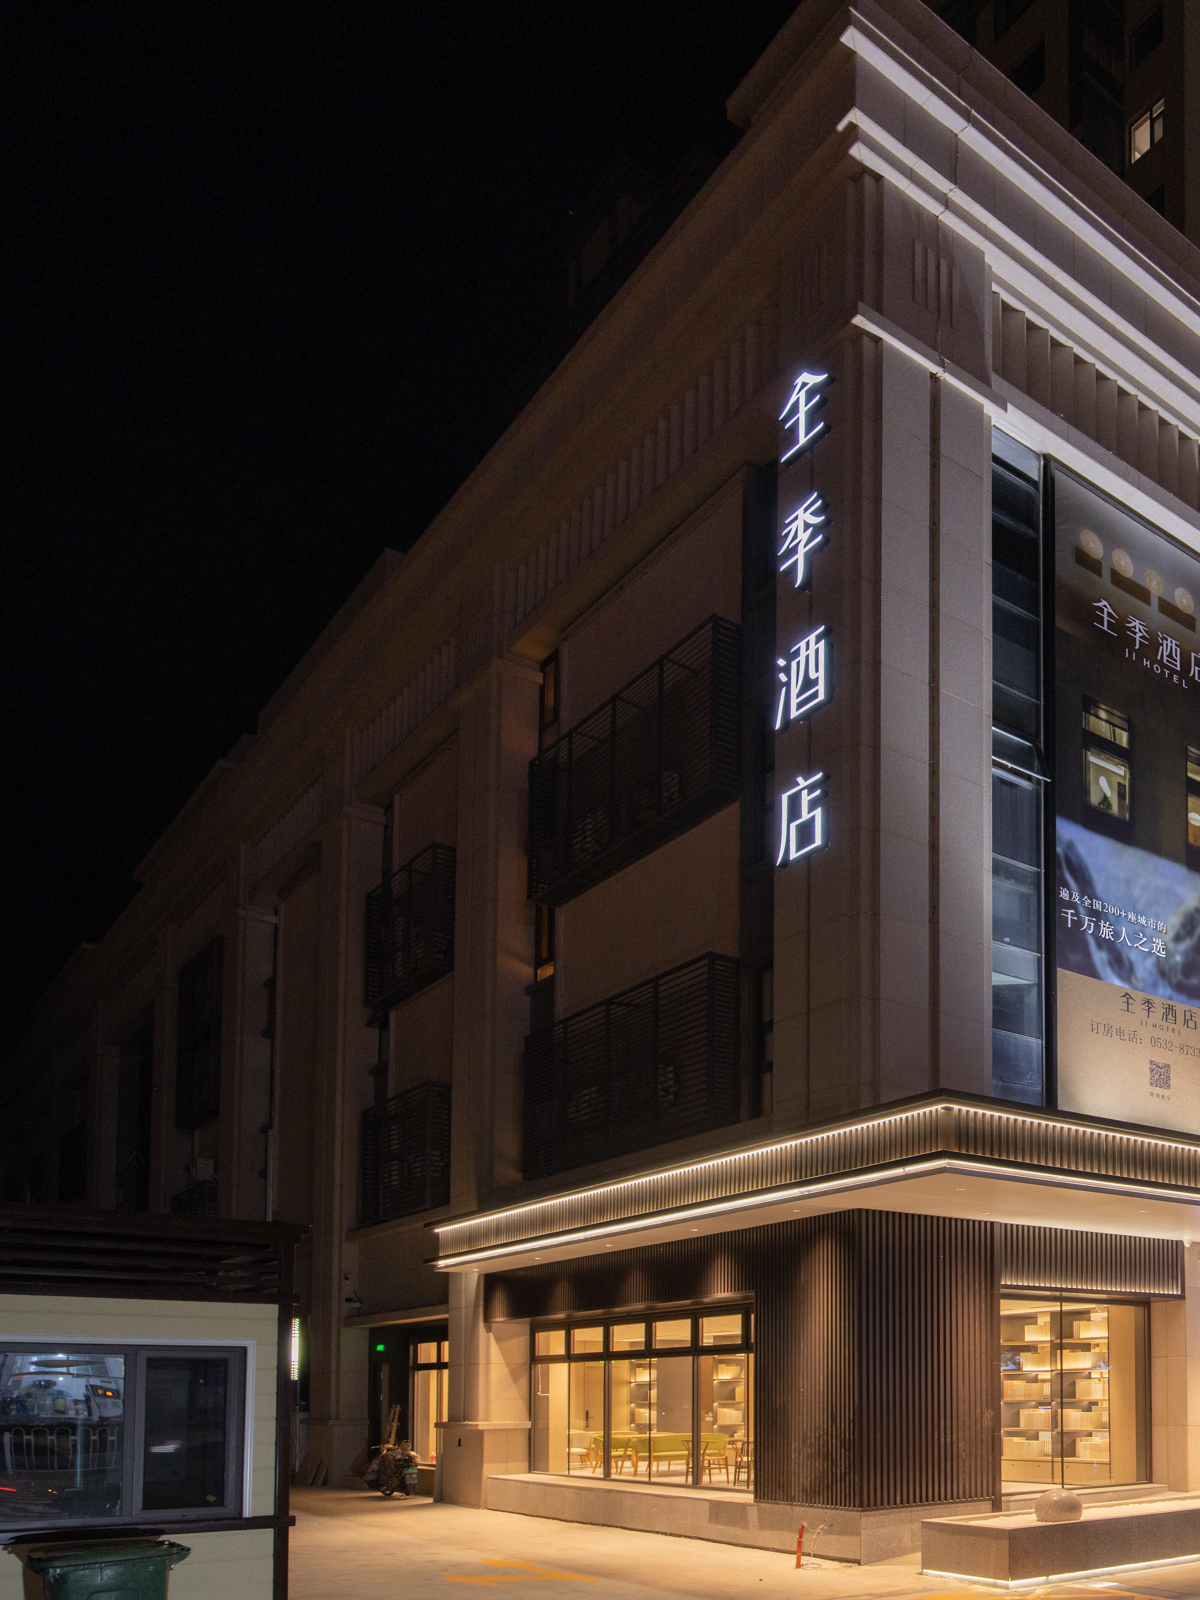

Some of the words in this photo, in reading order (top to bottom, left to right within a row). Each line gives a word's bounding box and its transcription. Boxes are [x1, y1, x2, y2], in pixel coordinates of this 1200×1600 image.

[775, 371, 829, 867] 全季酒店
[1143, 657, 1189, 689] HOTEL
[1059, 886, 1168, 934] 遍及全国200+座城市的
[1060, 908, 1167, 958] 千万旅人之选
[1120, 991, 1198, 1031] 全季酒店
[1152, 1022, 1183, 1036] HOTEL
